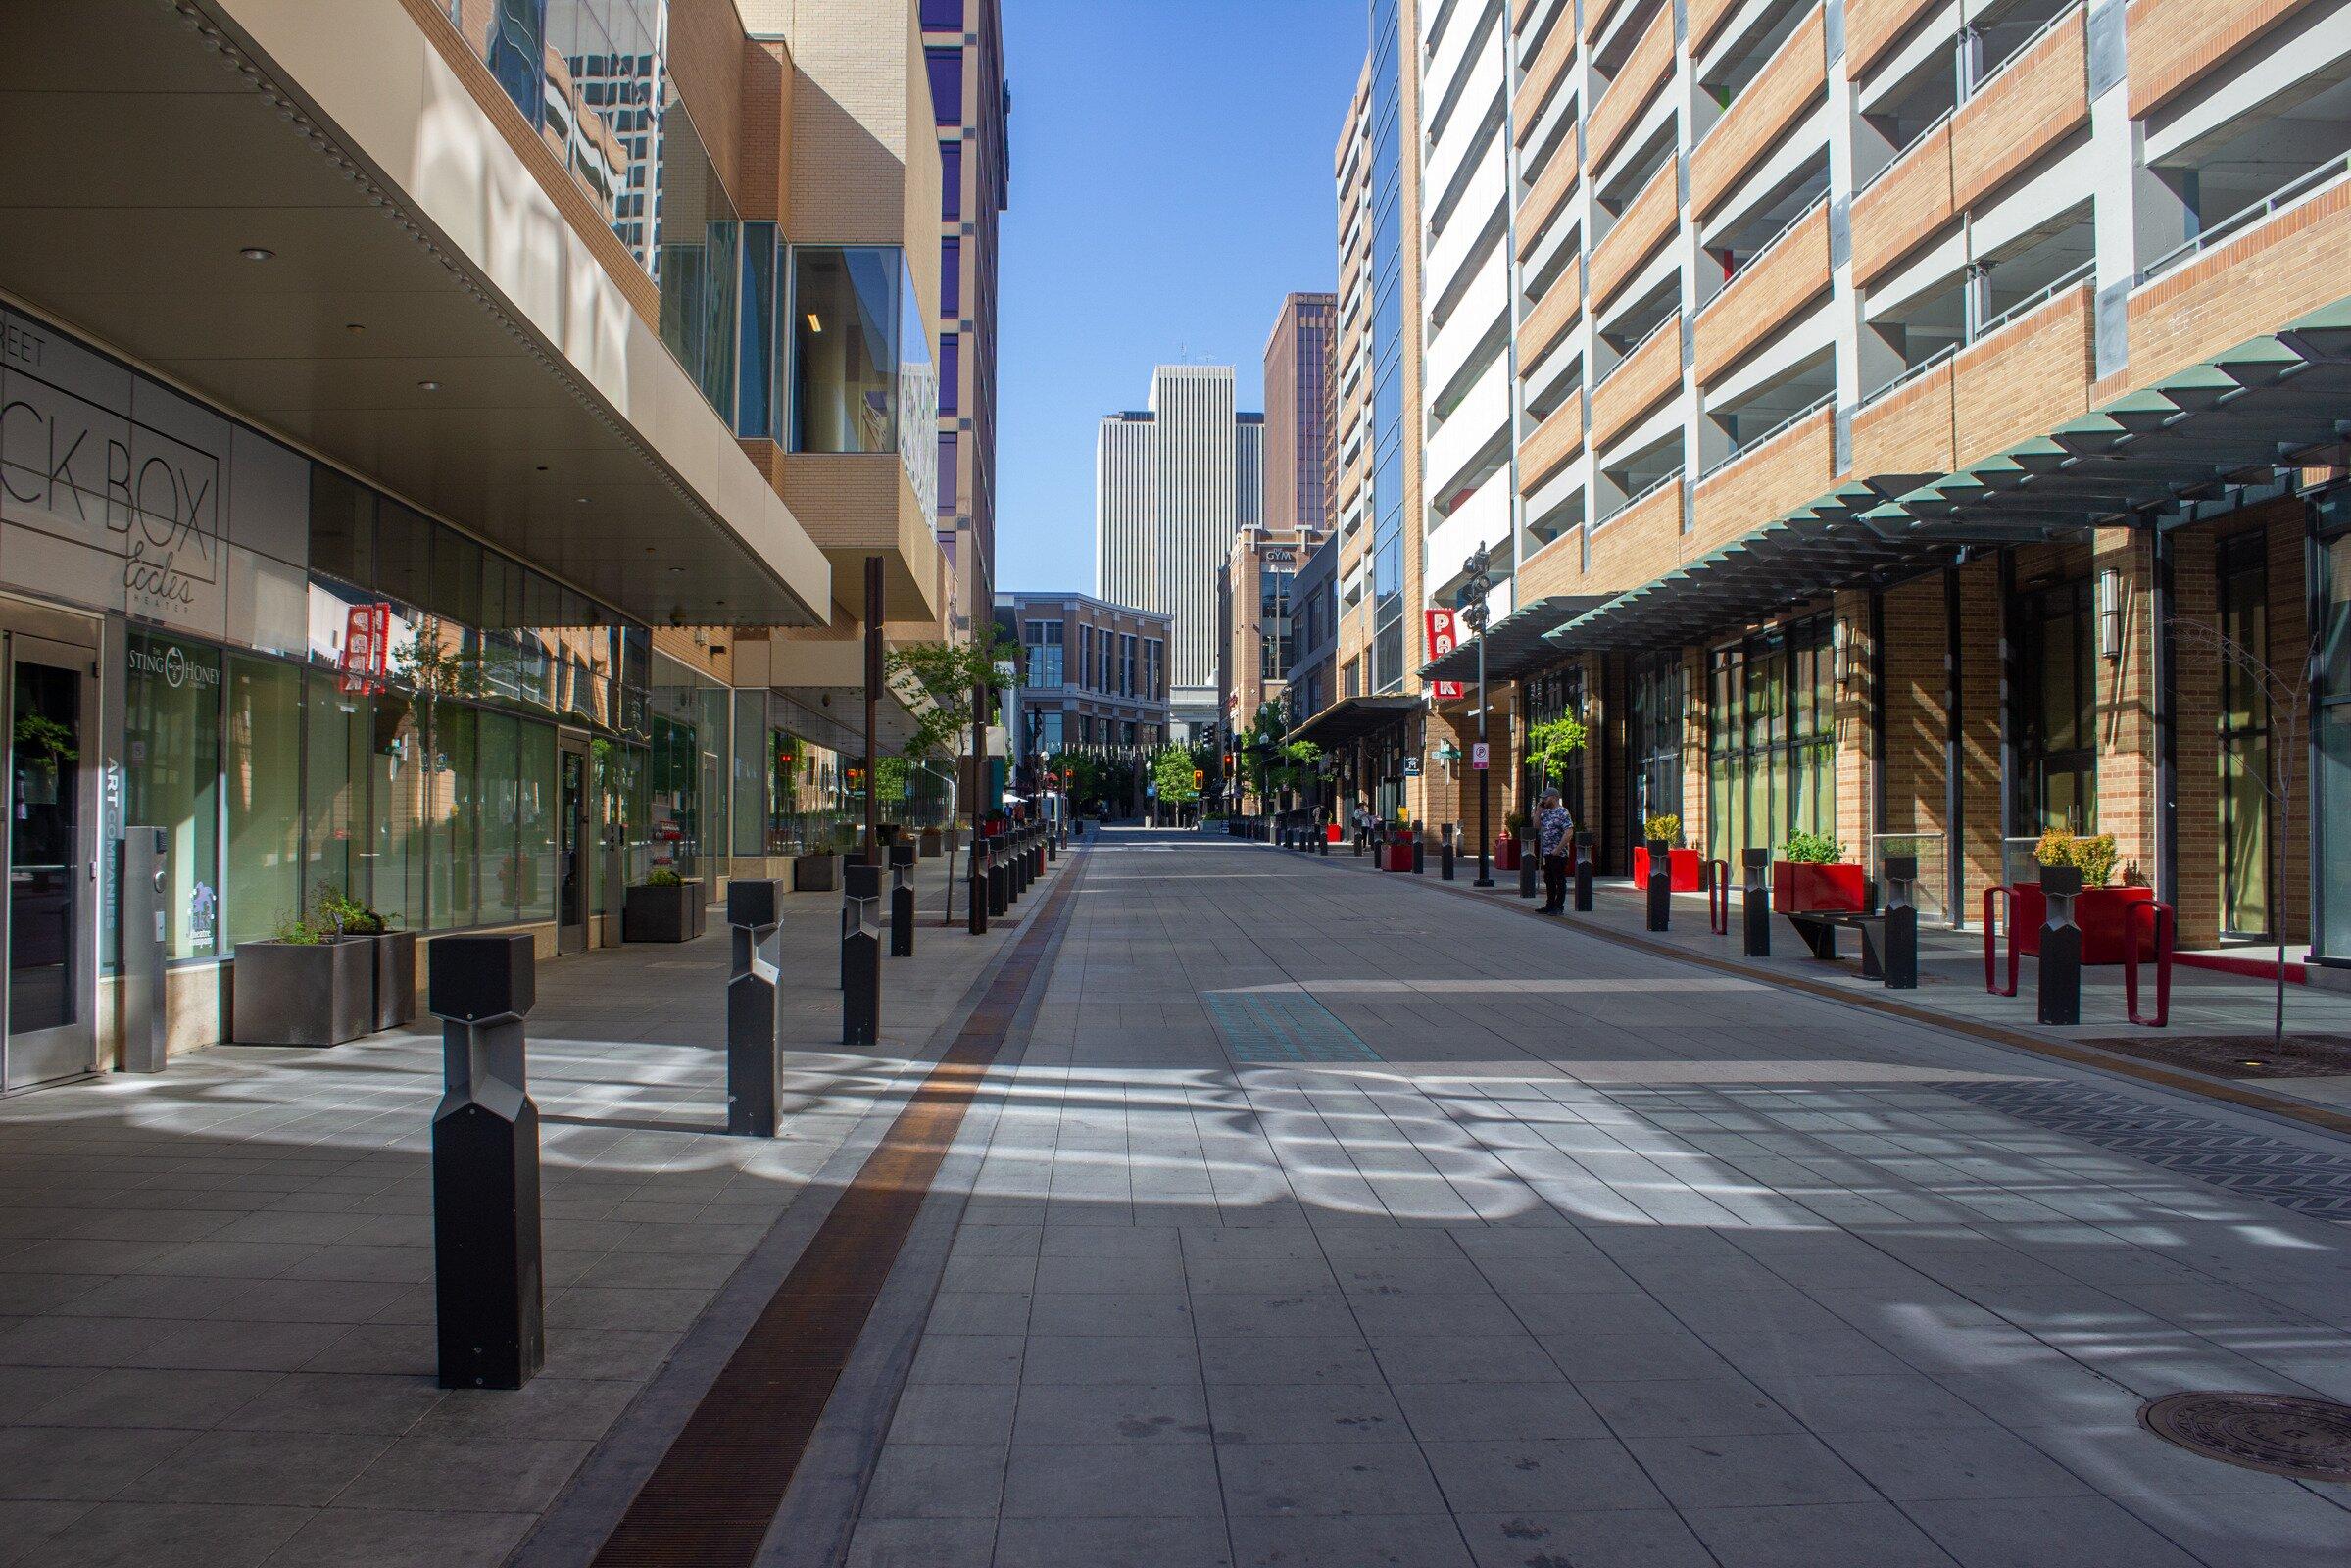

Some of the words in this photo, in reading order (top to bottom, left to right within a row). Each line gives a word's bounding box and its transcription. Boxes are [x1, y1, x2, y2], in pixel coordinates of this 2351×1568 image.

[0, 401, 87, 521] CK
[107, 439, 210, 561] BOX
[123, 540, 194, 603] Eccles
[1266, 551, 1292, 560] GYM
[129, 649, 164, 673] STING
[185, 661, 221, 685] HONEY
[1434, 613, 1457, 695] PAK
[108, 756, 119, 808] ART
[105, 809, 117, 929] COMPANIES
